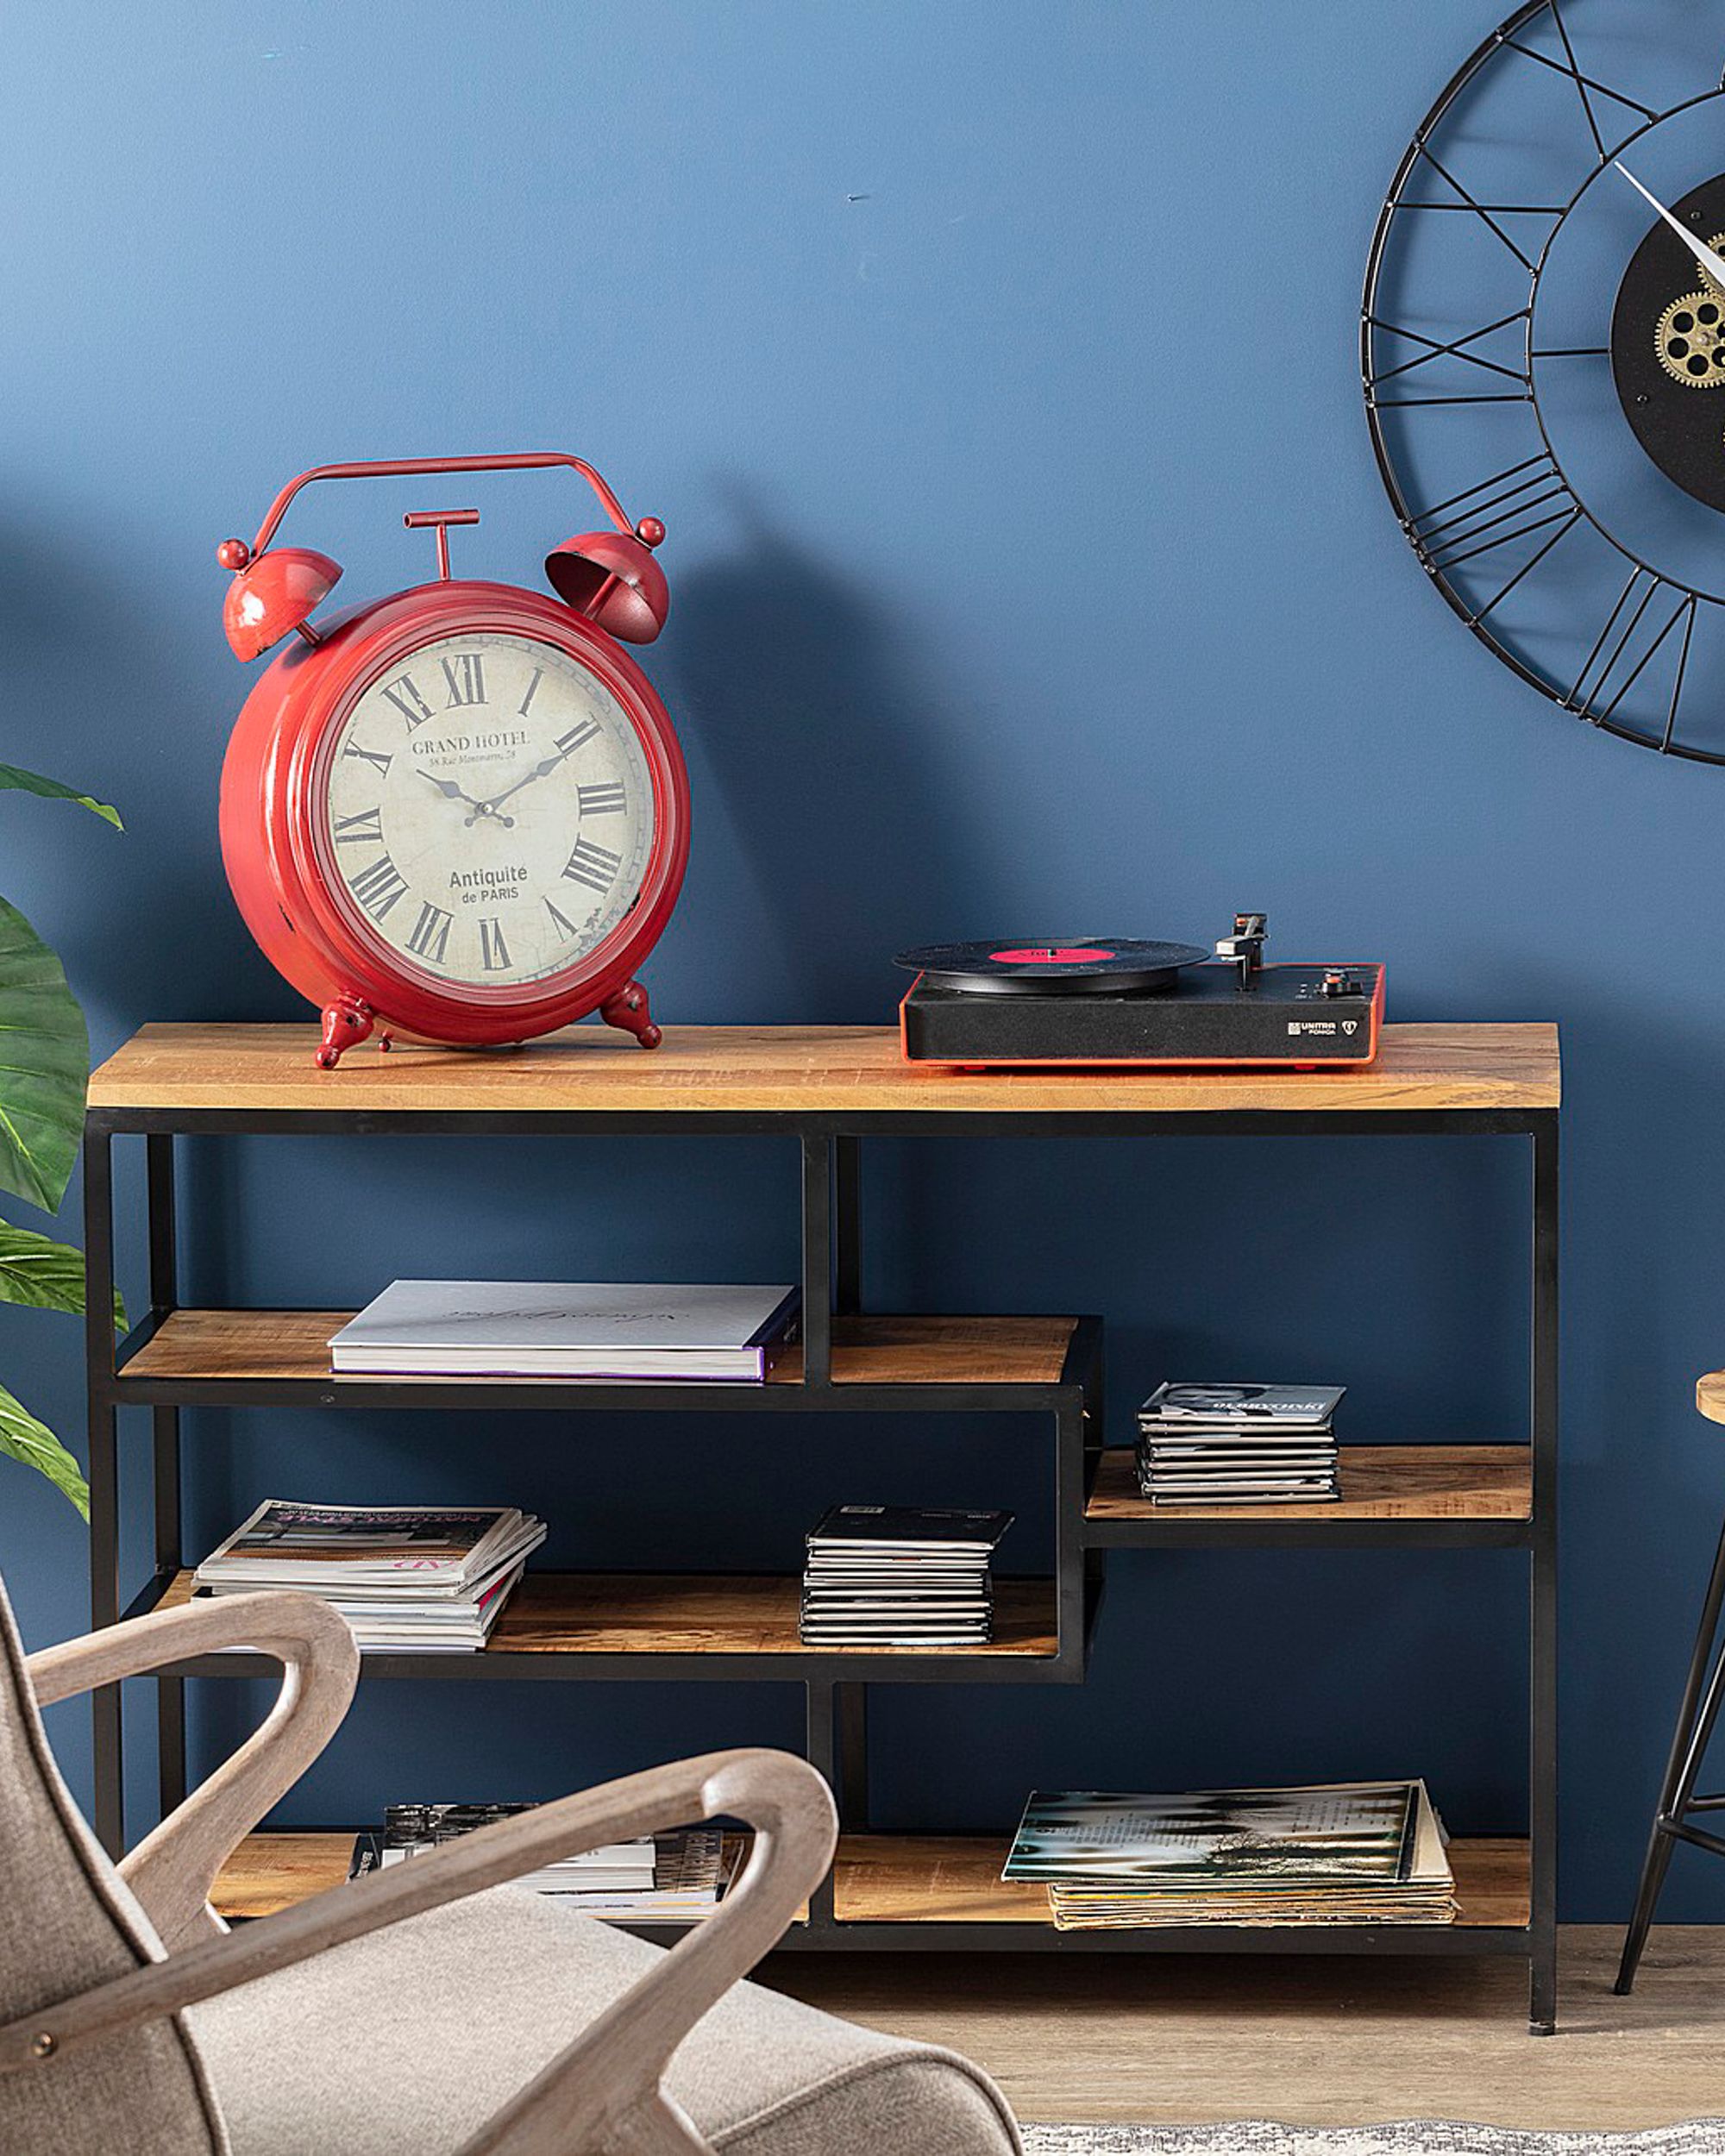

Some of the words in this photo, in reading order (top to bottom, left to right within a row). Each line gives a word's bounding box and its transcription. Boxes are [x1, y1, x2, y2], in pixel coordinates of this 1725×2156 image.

[380, 671, 436, 733] XI
[439, 653, 490, 709] XII
[518, 667, 545, 718] I
[342, 735, 394, 779] X
[412, 736, 470, 755] GRAND
[475, 731, 531, 749] HOTEL
[333, 805, 384, 845] IX
[576, 779, 628, 820] III
[347, 851, 411, 926] VIII
[561, 832, 623, 899] IIII
[462, 892, 477, 904] de
[480, 887, 519, 902] PARIS
[543, 895, 579, 944] V
[405, 900, 455, 966] VII
[479, 917, 513, 972] VI
